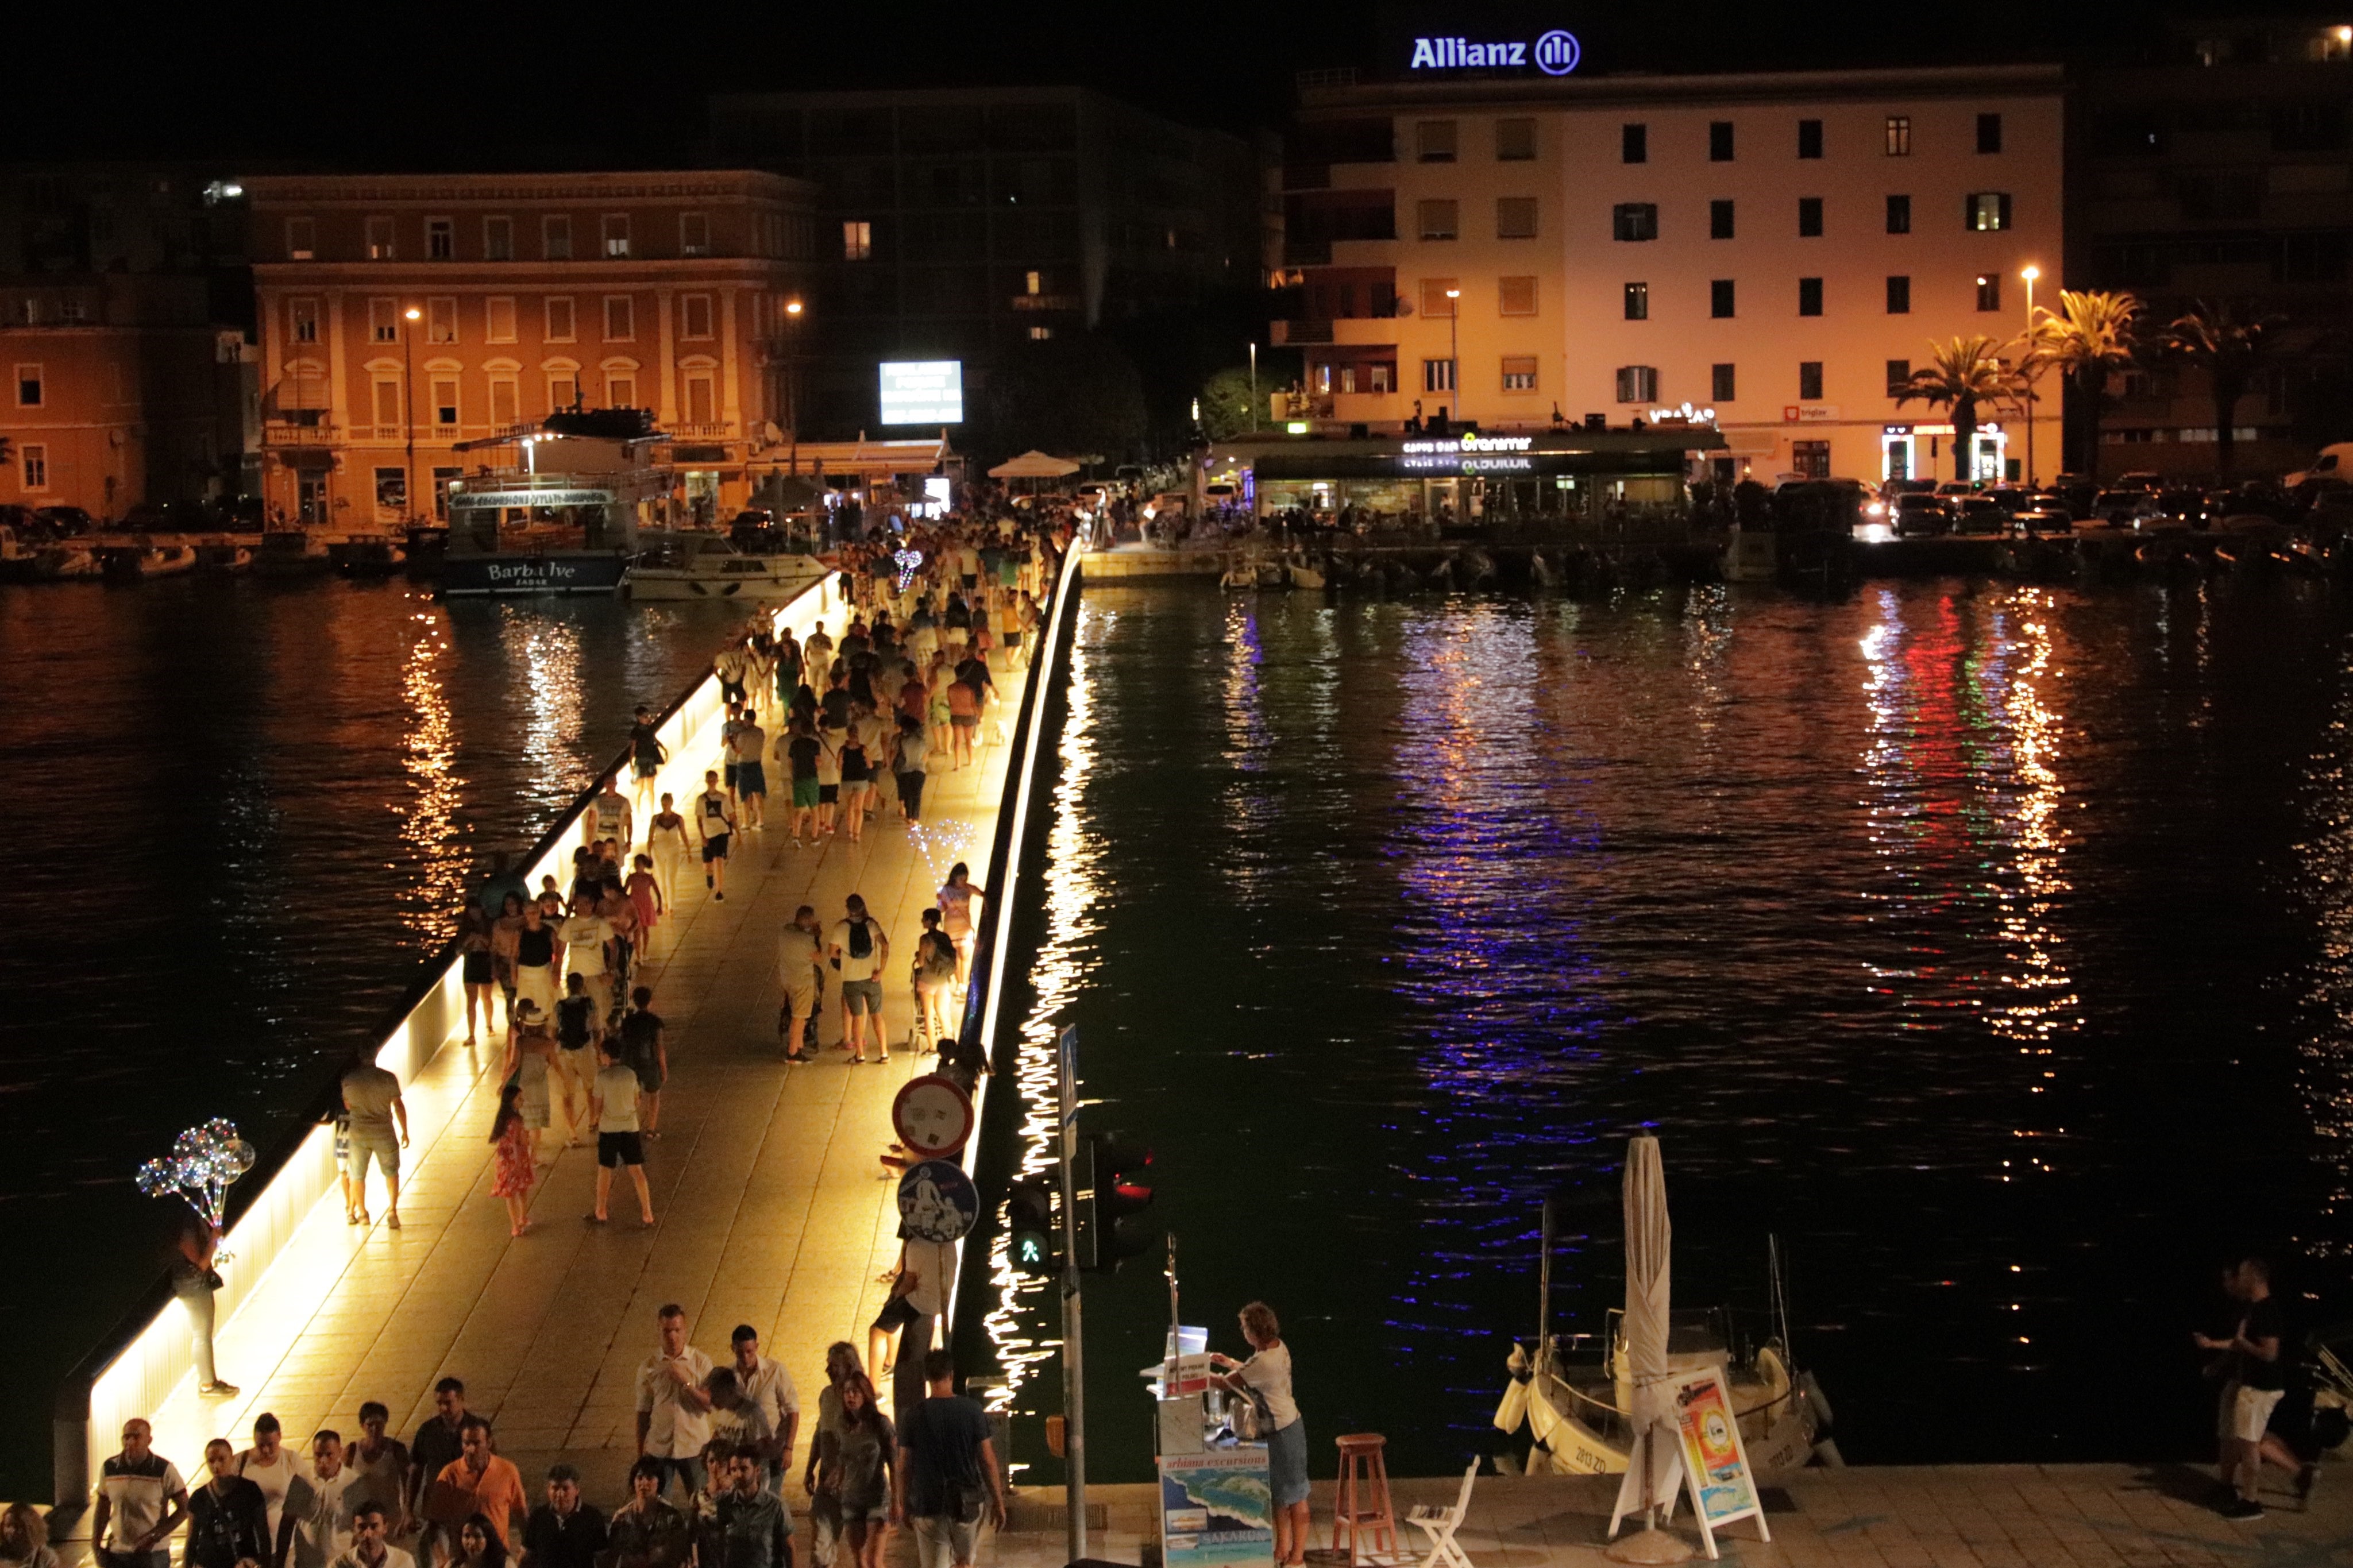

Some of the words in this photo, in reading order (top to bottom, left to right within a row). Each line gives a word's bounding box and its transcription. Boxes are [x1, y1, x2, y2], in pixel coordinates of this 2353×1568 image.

[1411, 37, 1526, 68] Allianz
[1461, 437, 1532, 451] branimir
[1166, 1457, 1203, 1469] arbiana
[1208, 1454, 1266, 1467] excursions
[1576, 1446, 1592, 1467] 2813
[1593, 1457, 1606, 1474] ZD
